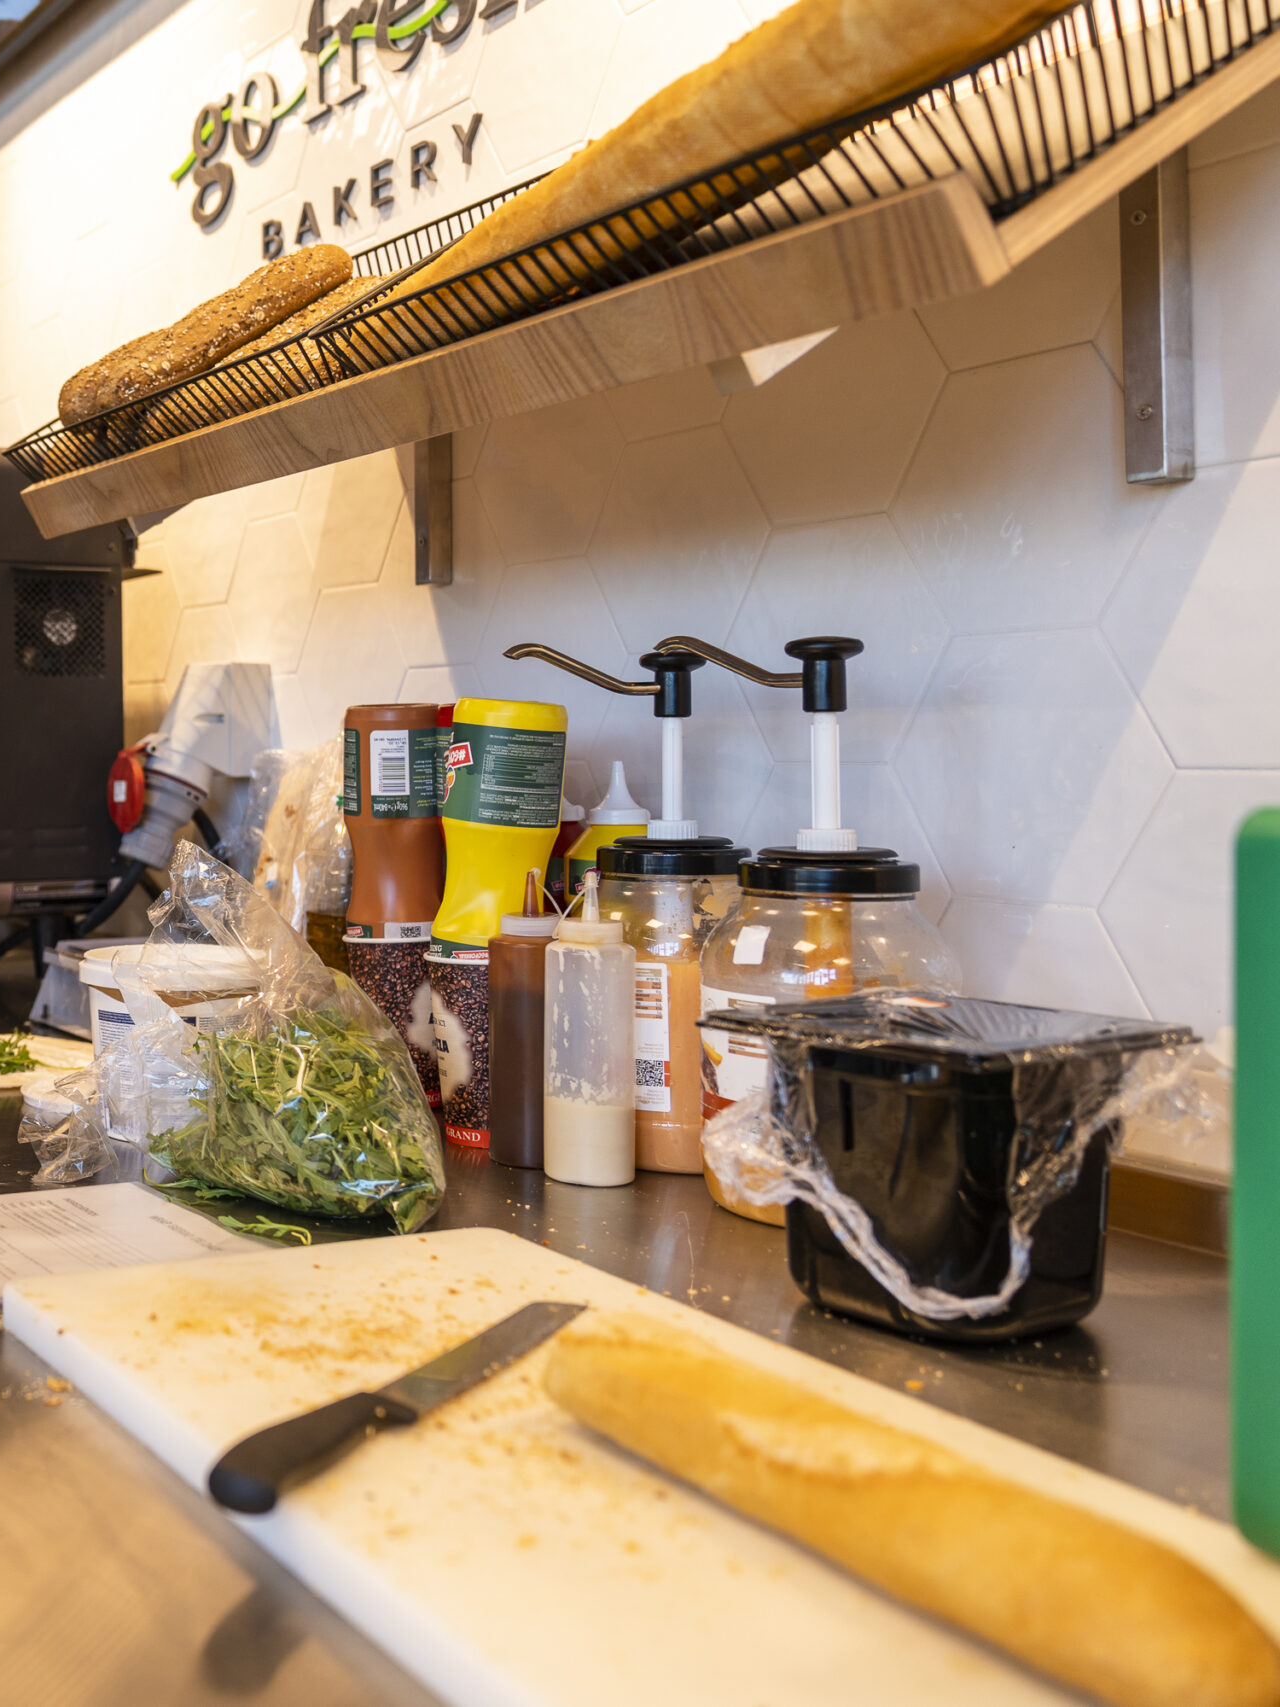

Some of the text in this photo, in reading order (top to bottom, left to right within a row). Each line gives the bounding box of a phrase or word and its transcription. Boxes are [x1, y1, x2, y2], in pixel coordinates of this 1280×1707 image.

[191, 0, 519, 227] go fres
[261, 112, 484, 262] BAKERY
[445, 1126, 481, 1142] GRAND
